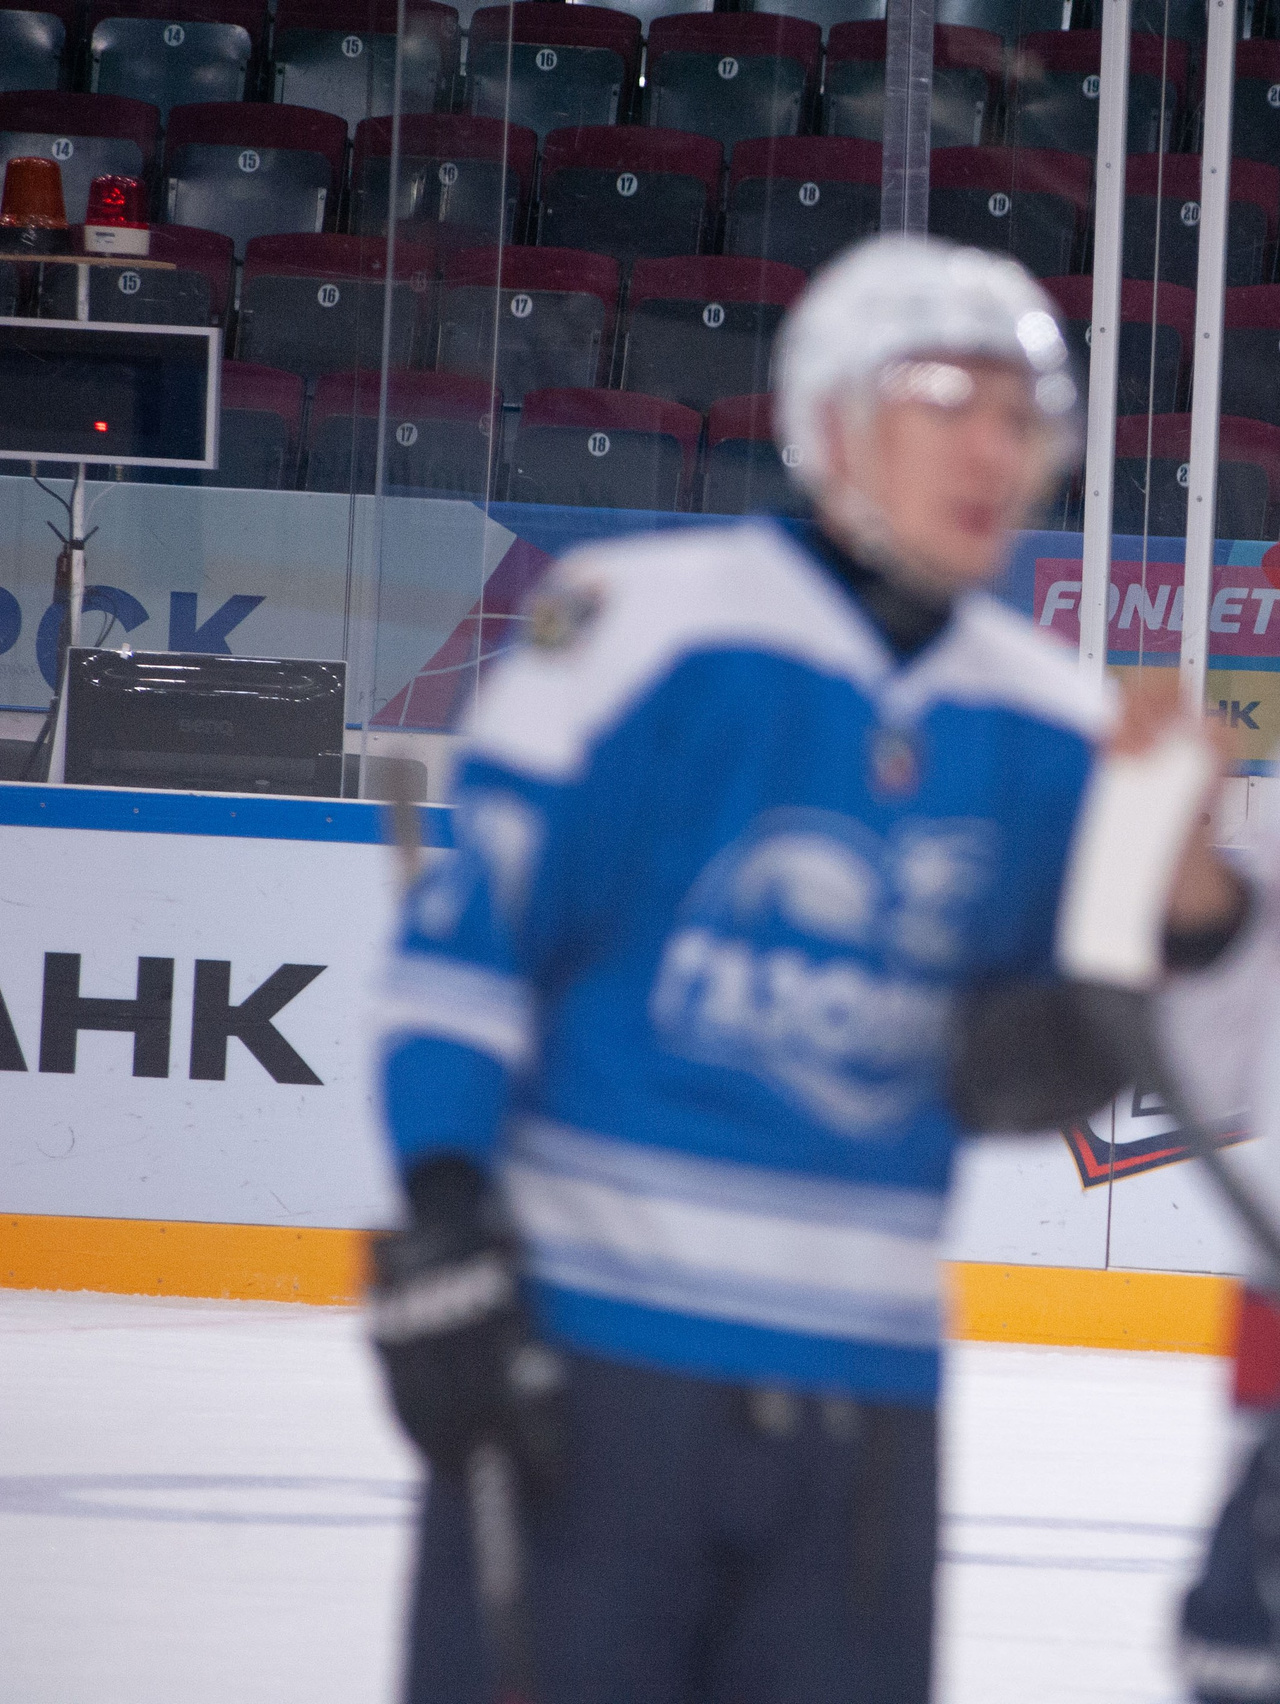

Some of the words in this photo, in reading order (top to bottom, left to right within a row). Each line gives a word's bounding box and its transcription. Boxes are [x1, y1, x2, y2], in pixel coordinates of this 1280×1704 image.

[168, 28, 181, 42] 14
[346, 39, 359, 53] 15
[541, 52, 554, 66] 16
[723, 61, 734, 74] 17
[1086, 79, 1099, 93] 19
[56, 142, 69, 156] 14
[243, 154, 256, 168] 15
[442, 167, 455, 181] 16
[621, 177, 633, 191] 17
[804, 187, 816, 201] 18
[993, 197, 1006, 211] 19
[1184, 206, 1198, 220] 20
[123, 275, 137, 290] 15
[323, 288, 336, 302] 16
[515, 298, 528, 313] 17
[708, 308, 721, 323] 18
[401, 426, 414, 441] 17
[592, 437, 606, 452] 18
[0, 585, 267, 690] СК
[0, 952, 328, 1086] НК
